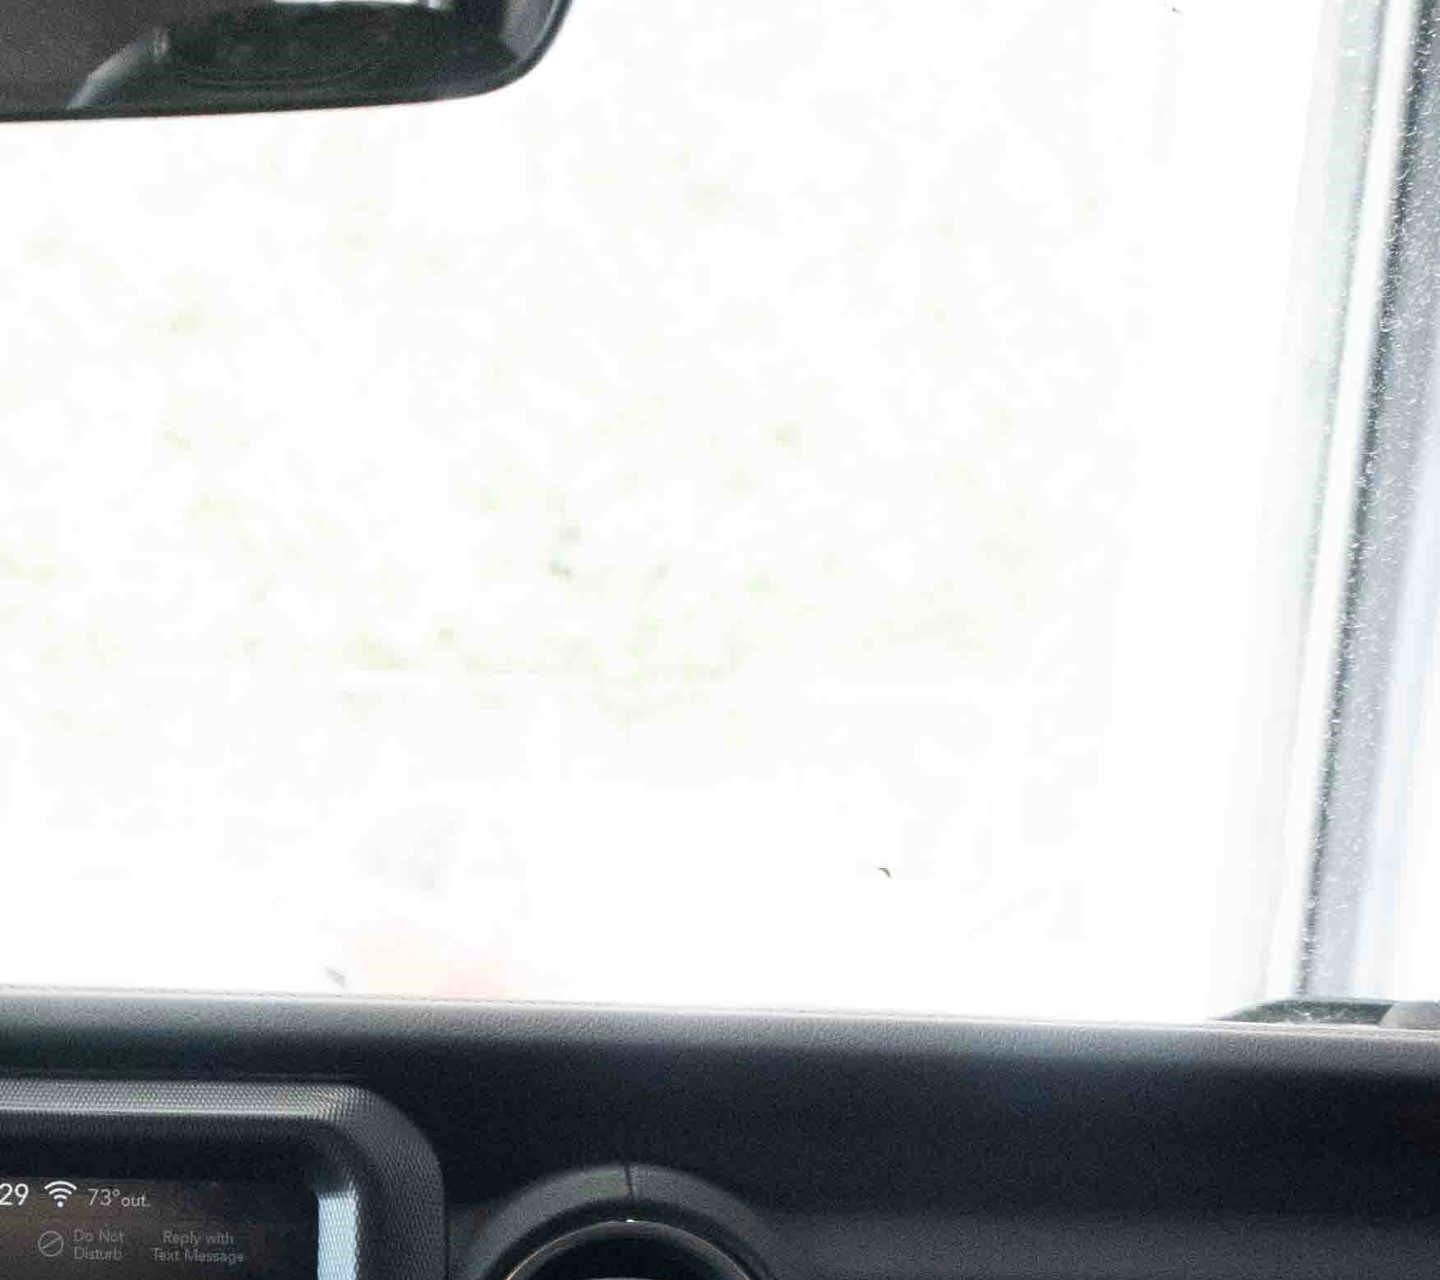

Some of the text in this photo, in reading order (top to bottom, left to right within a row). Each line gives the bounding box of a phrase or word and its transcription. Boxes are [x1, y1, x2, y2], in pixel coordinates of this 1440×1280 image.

[73, 1229, 94, 1243] Do
[162, 1230, 234, 1247] Reply with
